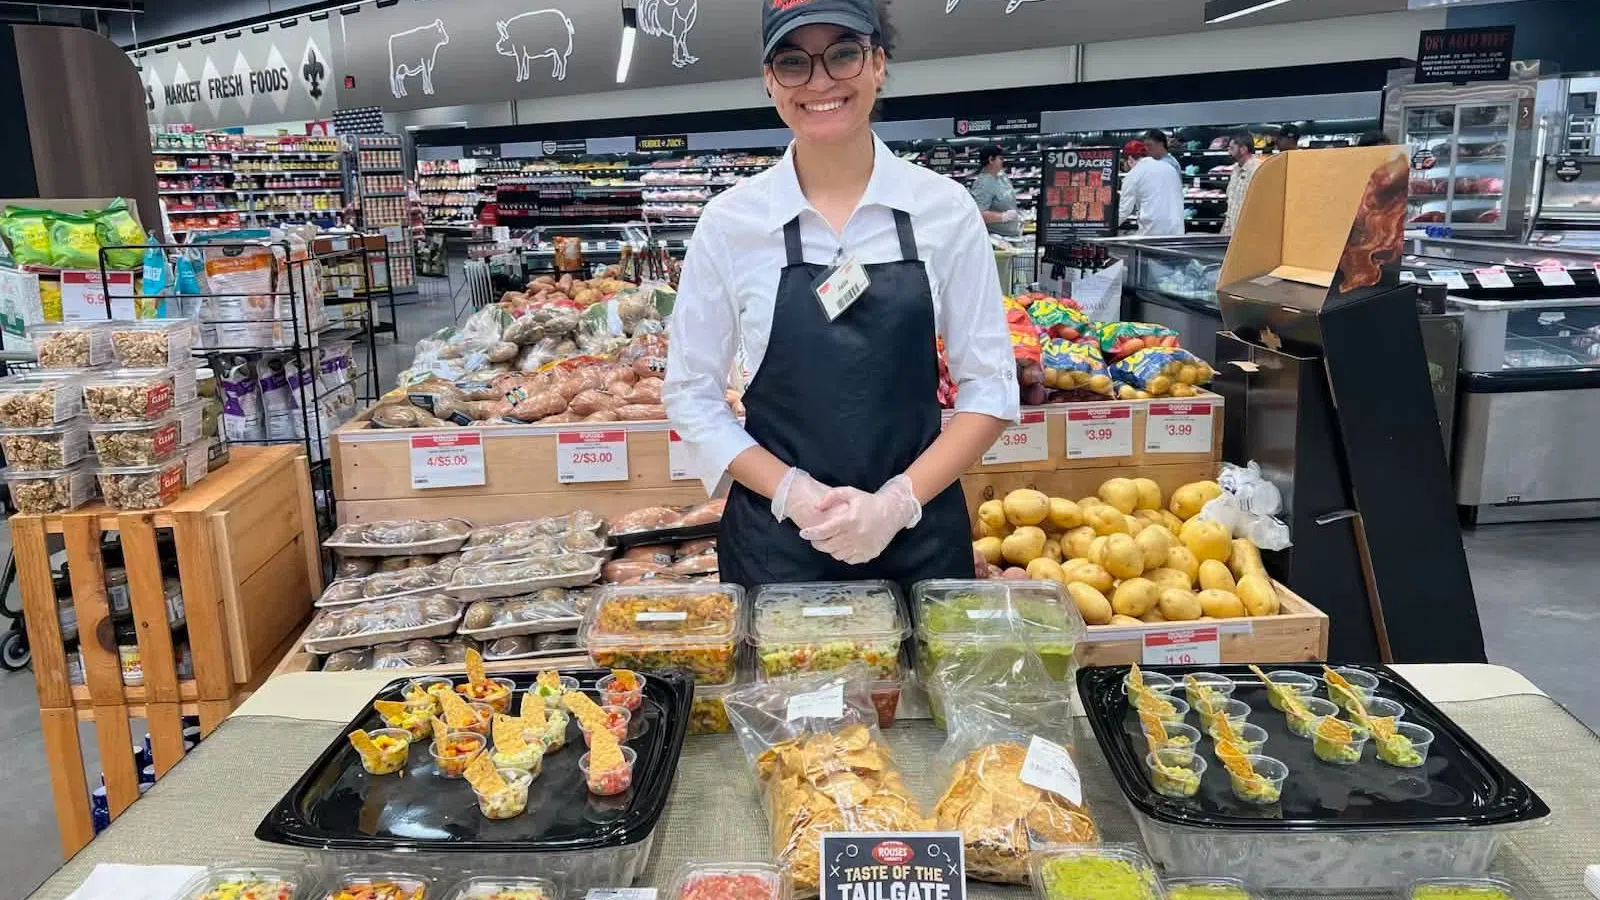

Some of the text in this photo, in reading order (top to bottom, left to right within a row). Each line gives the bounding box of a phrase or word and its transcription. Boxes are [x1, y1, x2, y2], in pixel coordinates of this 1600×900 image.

[164, 80, 200, 106] MARKET
[208, 74, 244, 100] FRESH
[249, 67, 289, 94] FOODS
[1047, 151, 1078, 168] $10
[1078, 159, 1113, 167] PACKS
[427, 455, 467, 467] 4/$5.00
[573, 452, 612, 463] 2/$3.00
[878, 847, 908, 857] ROUSES
[844, 866, 944, 882] TASTE OF THE
[838, 882, 950, 900] TAILGATE
